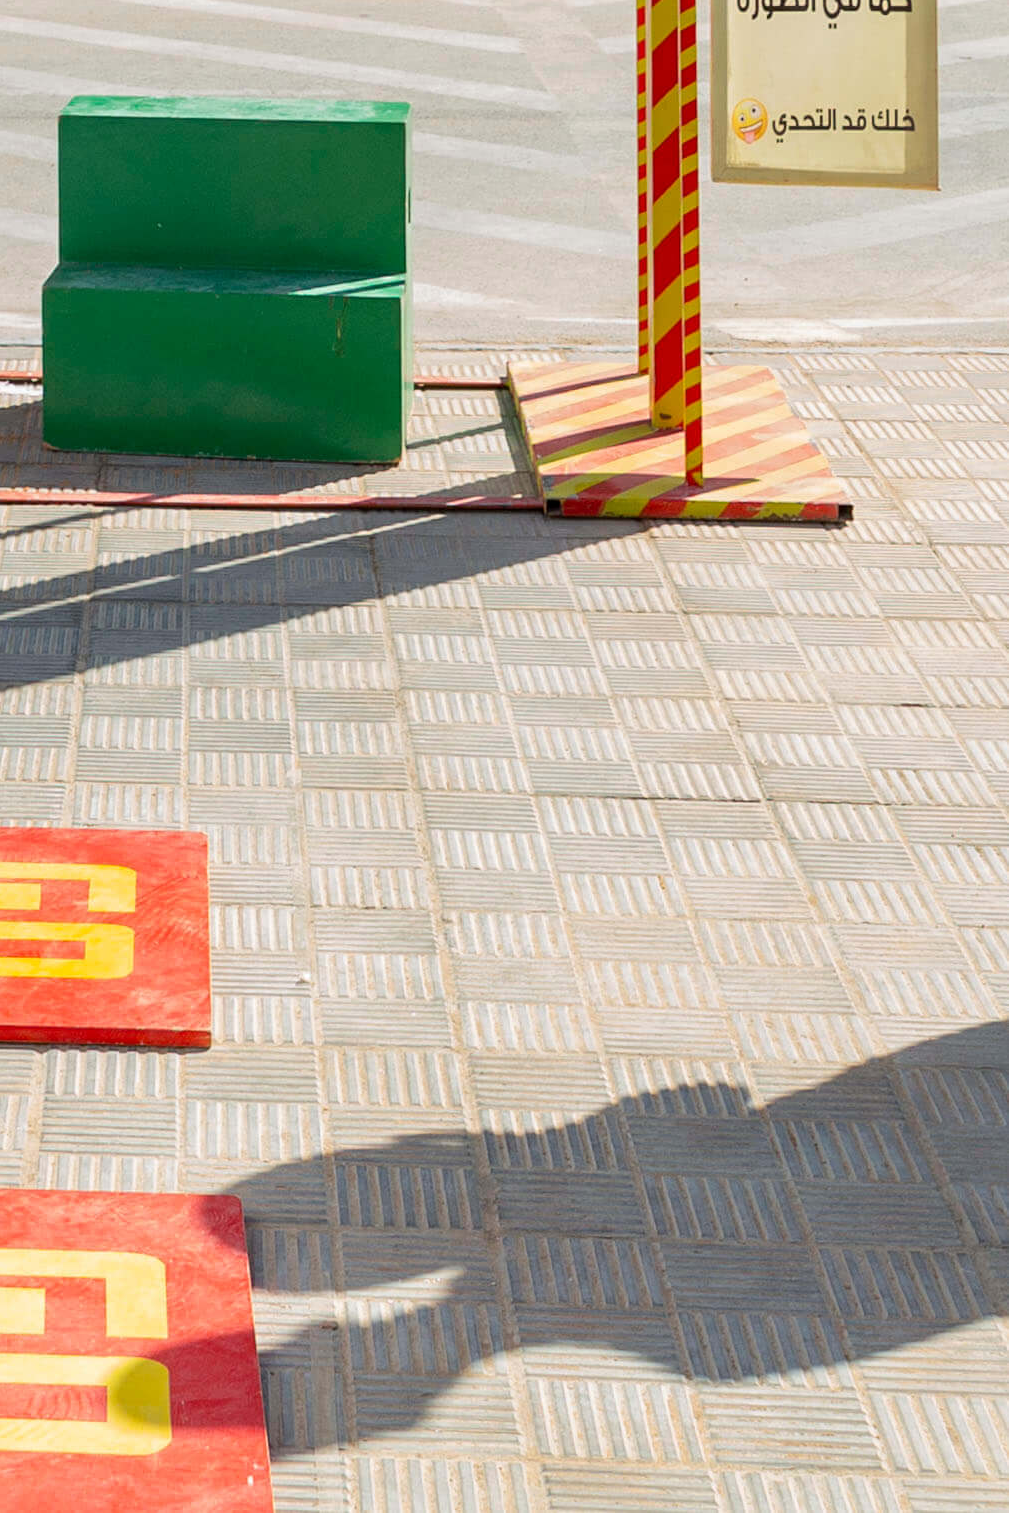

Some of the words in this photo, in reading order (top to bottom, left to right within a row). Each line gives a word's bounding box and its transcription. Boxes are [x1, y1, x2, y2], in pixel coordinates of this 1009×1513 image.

[772, 109, 837, 143] التحدي
[842, 108, 867, 131] قد
[872, 109, 915, 132] خلك
